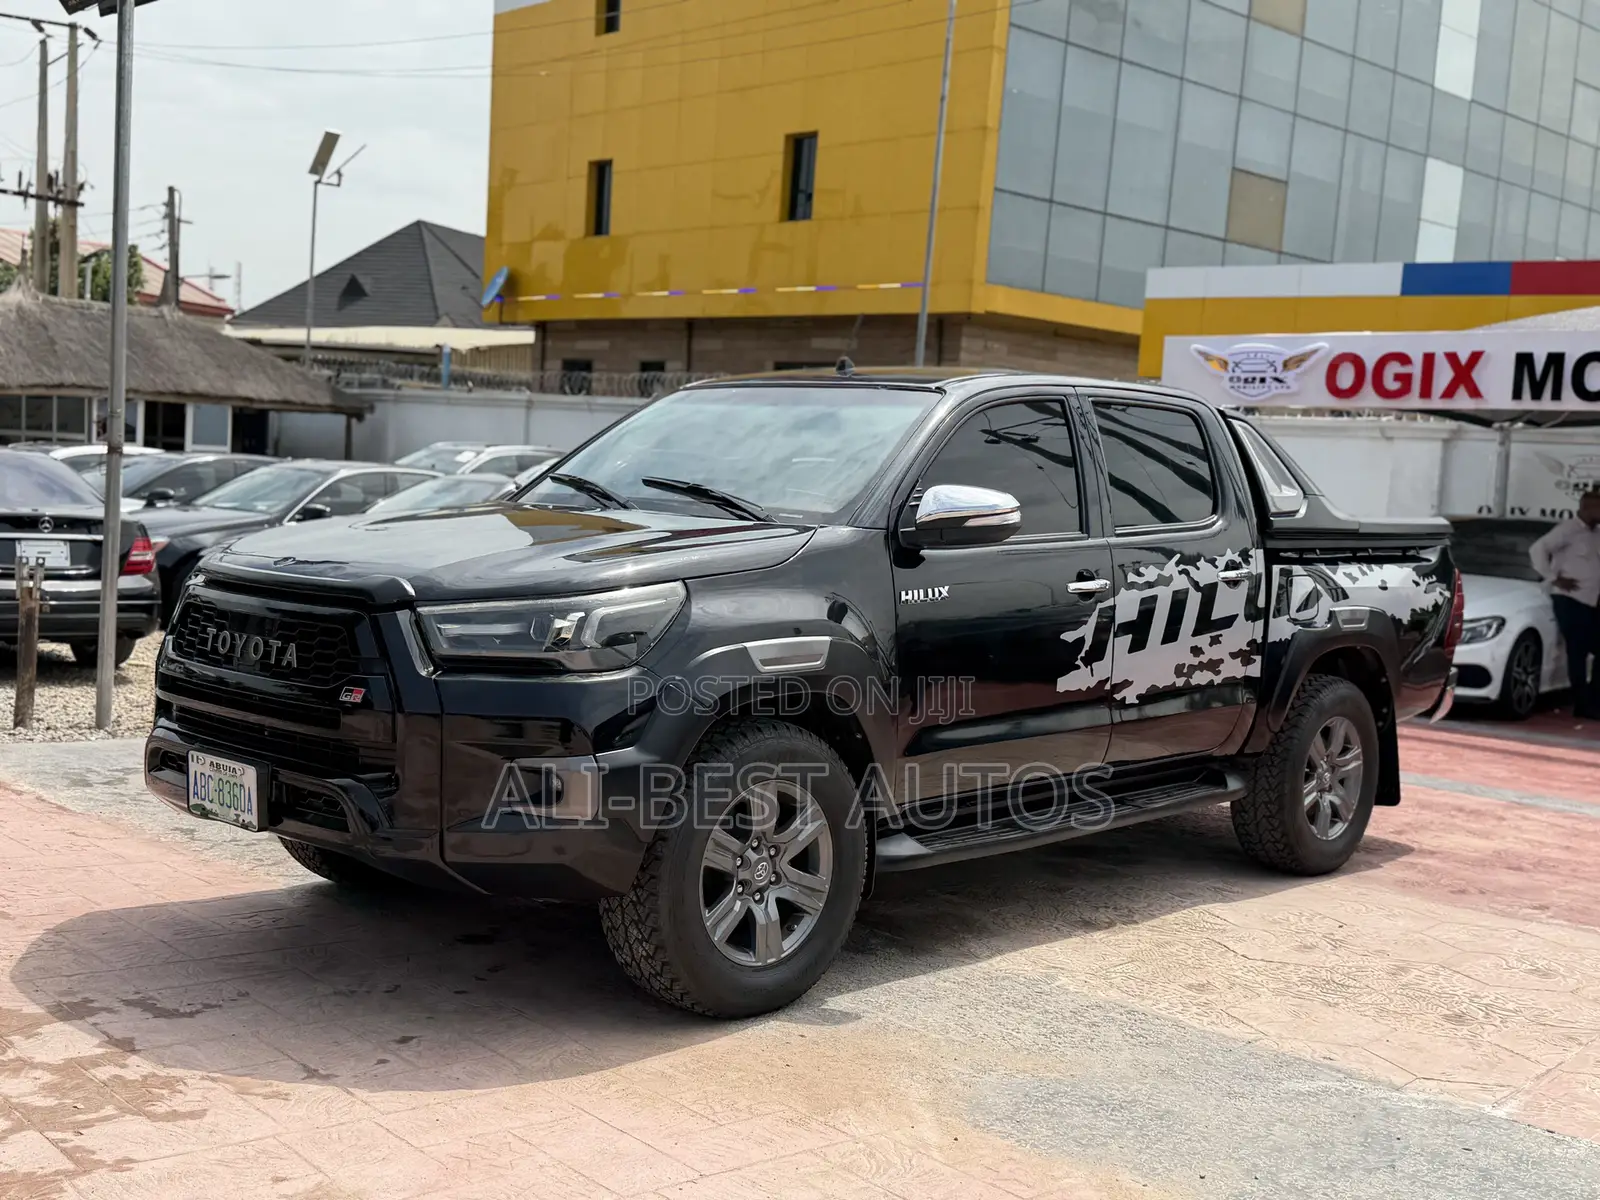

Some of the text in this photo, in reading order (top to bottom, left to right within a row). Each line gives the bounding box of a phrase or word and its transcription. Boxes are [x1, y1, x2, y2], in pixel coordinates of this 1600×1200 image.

[1325, 351, 1486, 400] OGIX
[899, 586, 950, 604] HILUX
[207, 627, 297, 668] TOYOTA
[340, 689, 364, 702] GR
